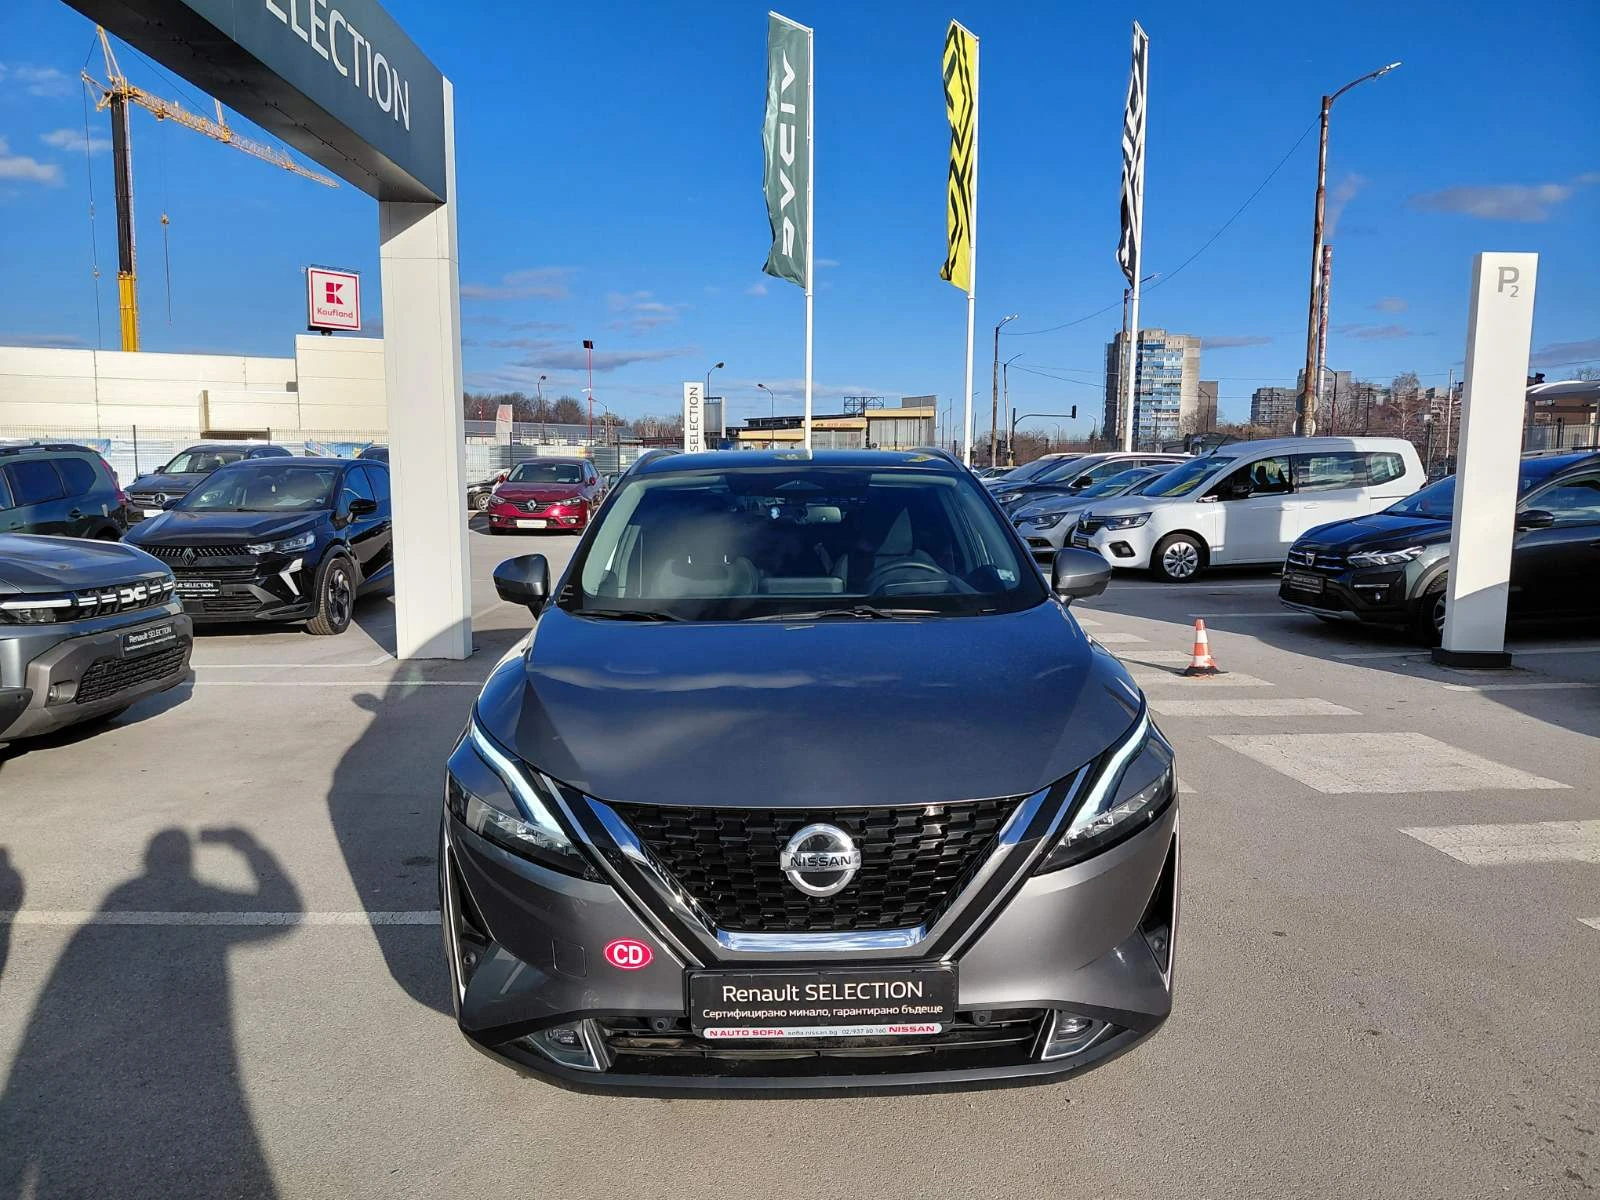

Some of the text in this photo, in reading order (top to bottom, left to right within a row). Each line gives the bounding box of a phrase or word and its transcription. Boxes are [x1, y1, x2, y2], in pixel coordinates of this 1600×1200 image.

[266, 0, 409, 131] LECTION
[317, 307, 354, 319] Kaufland
[689, 386, 699, 452] SELECTION
[128, 631, 148, 643] Renault
[148, 626, 172, 639] SELECTION
[790, 855, 851, 867] NISSAN
[613, 944, 643, 965] CD
[723, 981, 923, 1003] Renault SELECTION
[702, 1004, 944, 1020] Сертифицирано минало, гарантирано бъдеще
[720, 1029, 749, 1037] AUTO
[752, 1028, 784, 1036] SOFIA
[889, 1025, 935, 1033] NISSAN
